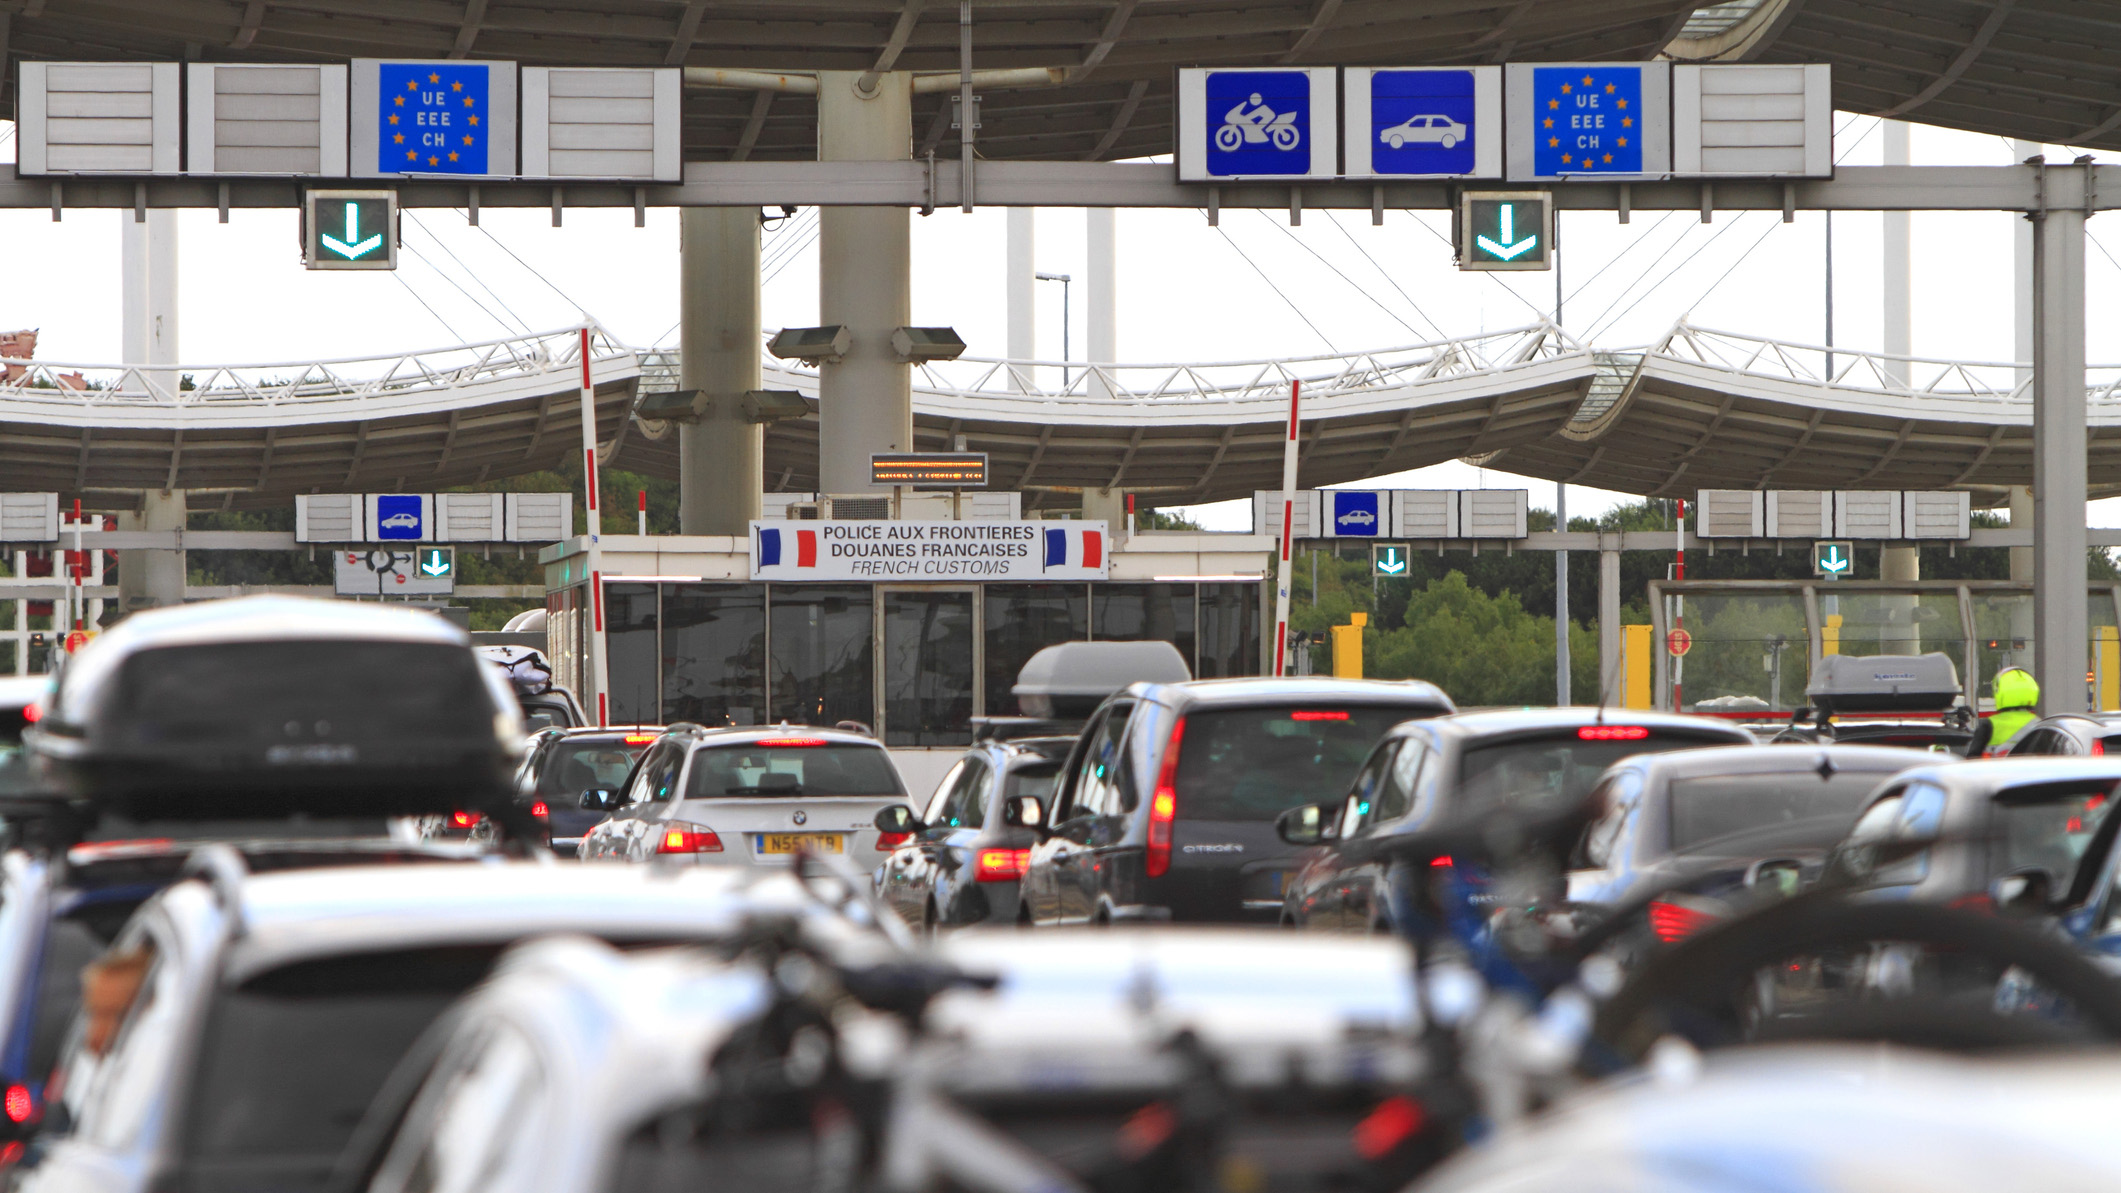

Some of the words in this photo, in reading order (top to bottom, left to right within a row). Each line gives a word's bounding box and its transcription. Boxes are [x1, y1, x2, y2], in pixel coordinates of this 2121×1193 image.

[422, 91, 445, 106] UE
[1576, 94, 1599, 108] UE
[416, 111, 451, 126] EEE
[1571, 114, 1605, 129] EEE
[422, 132, 445, 147] CH
[1577, 135, 1599, 149] CH
[824, 526, 881, 539] POLICE
[887, 526, 924, 539] AUX
[930, 526, 1034, 540] FRONTIERES
[832, 543, 916, 557] DOUANES
[922, 543, 1028, 557] FRANCAISES
[851, 561, 919, 575] FRENCH
[924, 560, 1010, 575] CUSTOMS
[1673, 632, 1683, 652] STOP
